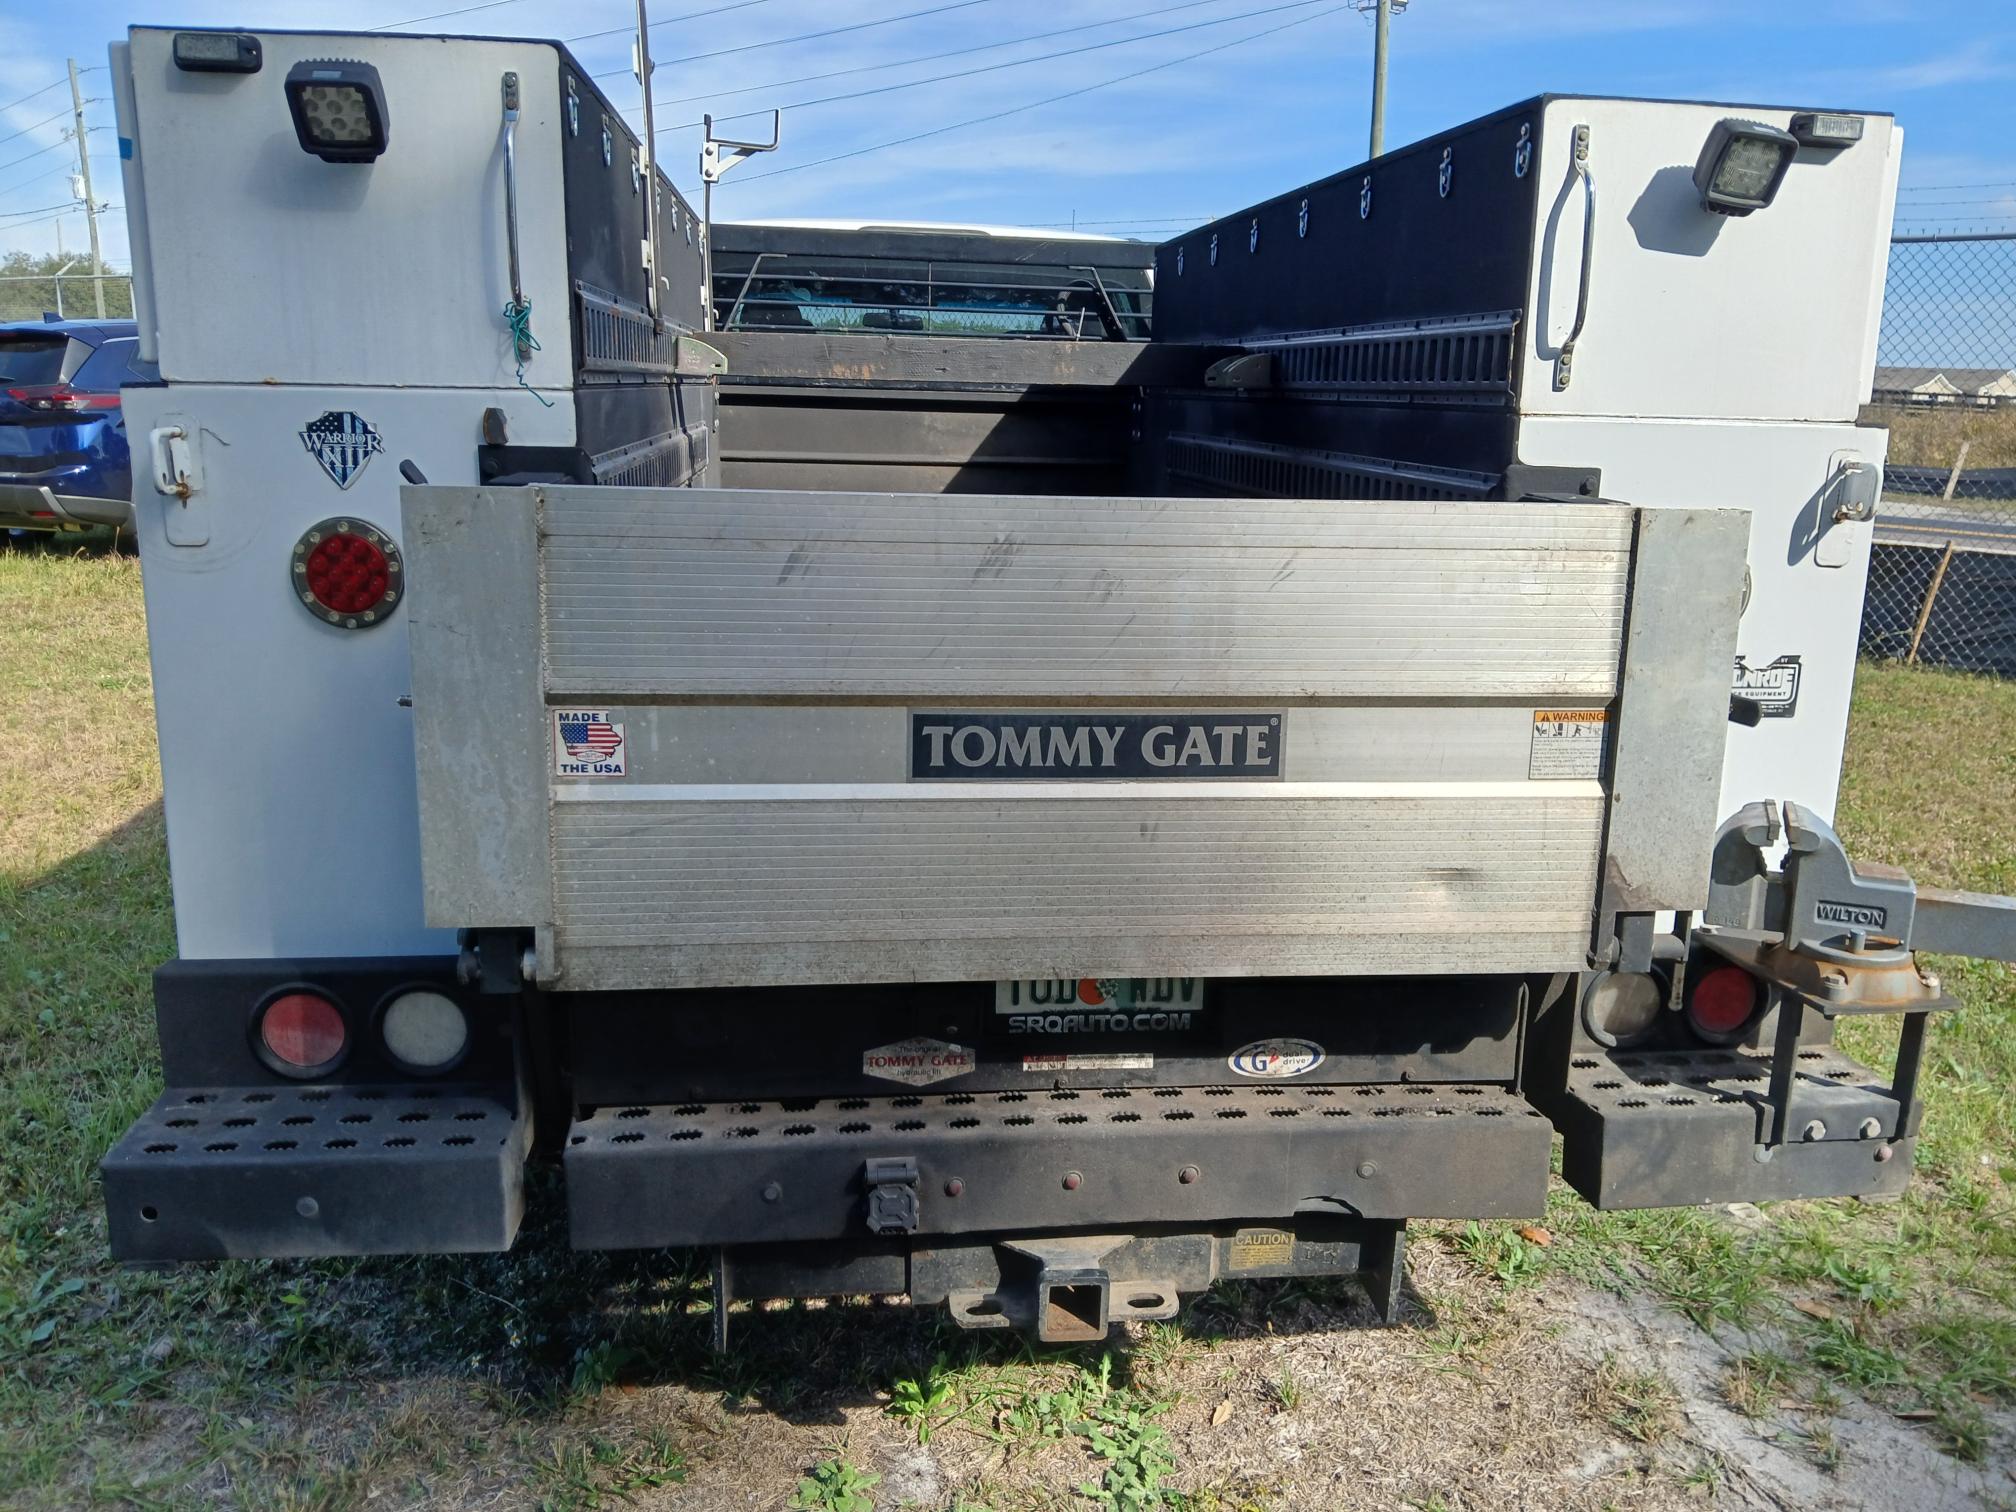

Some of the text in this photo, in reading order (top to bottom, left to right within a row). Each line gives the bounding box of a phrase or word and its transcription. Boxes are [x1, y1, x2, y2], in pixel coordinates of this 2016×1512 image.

[301, 431, 382, 451] WARRIOR
[558, 713, 600, 722] MADE
[1552, 712, 1604, 721] WARNING
[922, 725, 1126, 767] TOMMY
[560, 764, 623, 773] THE USA
[1817, 903, 1885, 927] WILTON
[1008, 1013, 1192, 1034] SRQAUTO.COM
[1282, 1050, 1303, 1058] dual
[867, 1054, 968, 1067] TOMMY GATE
[1235, 1233, 1289, 1245] CAUTION
